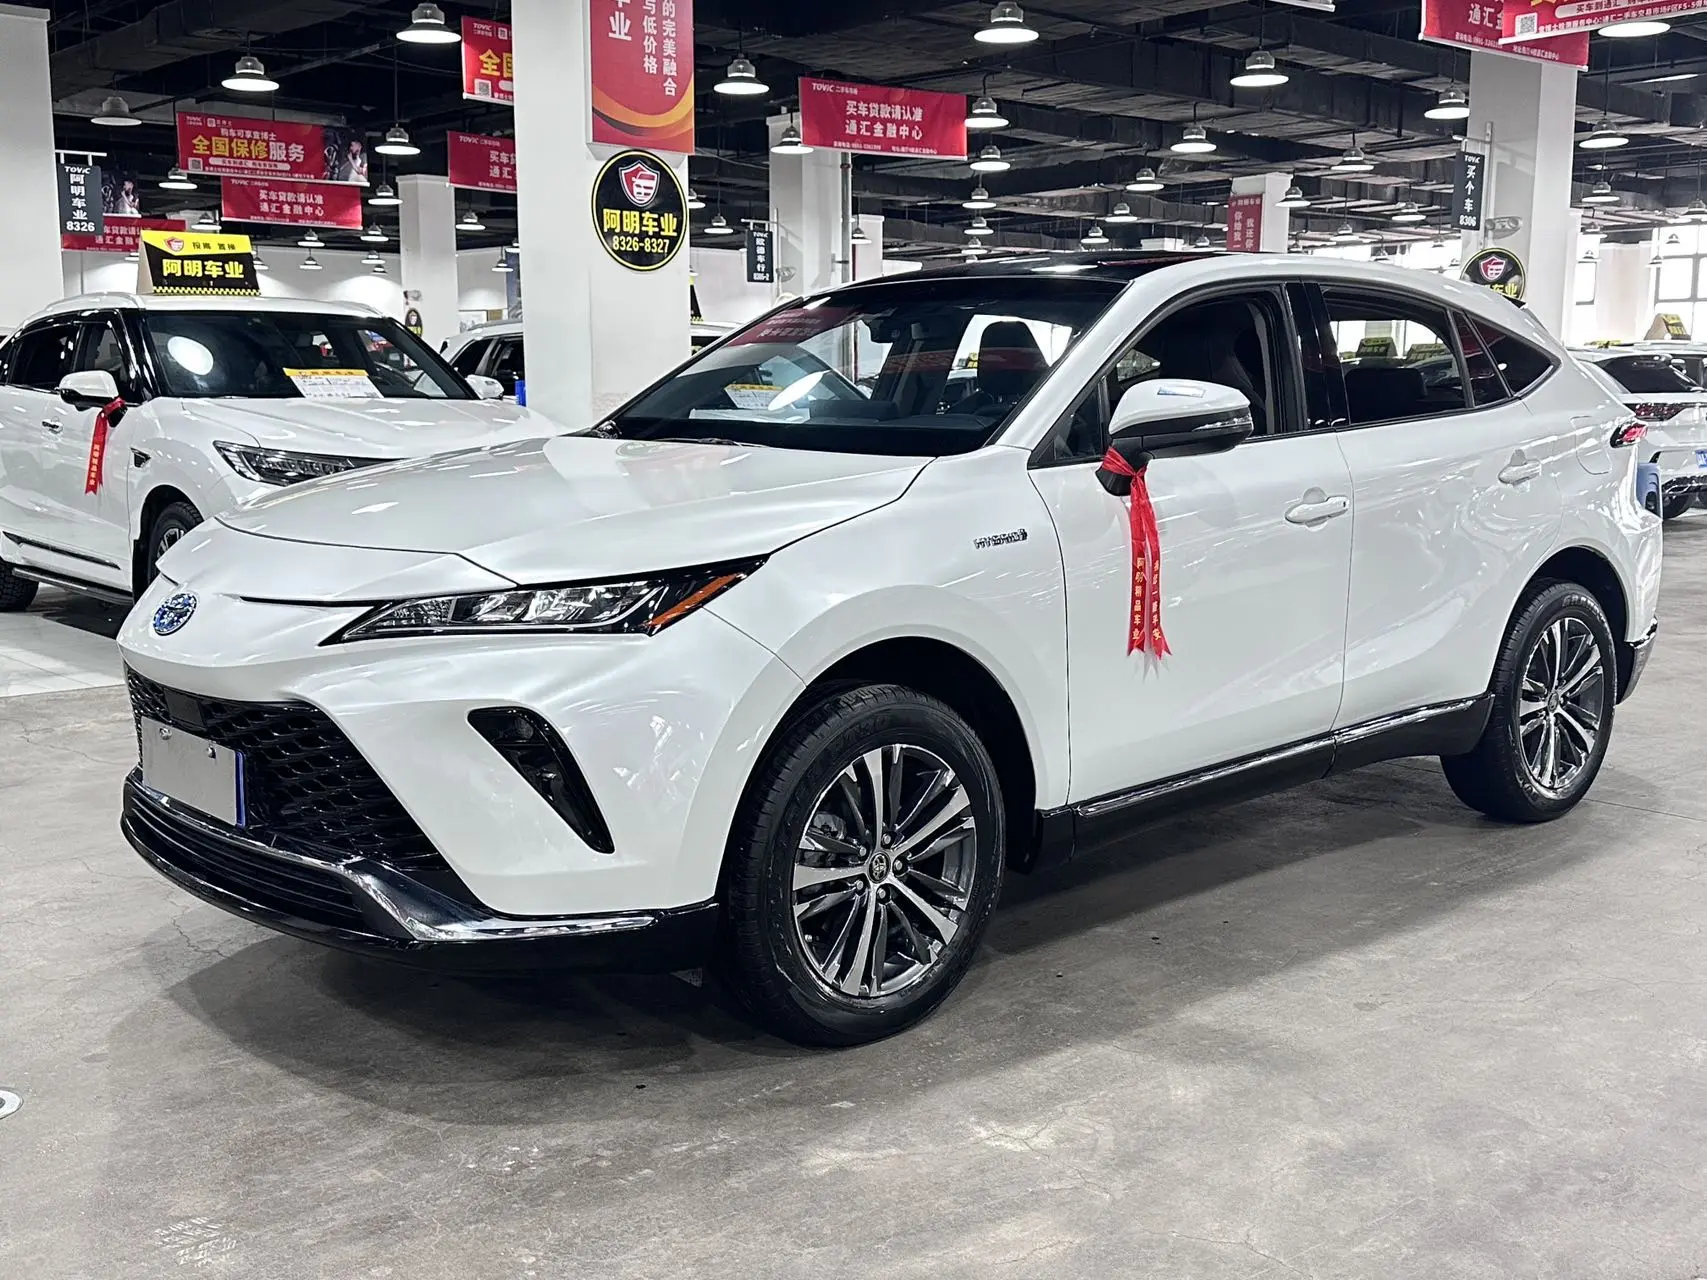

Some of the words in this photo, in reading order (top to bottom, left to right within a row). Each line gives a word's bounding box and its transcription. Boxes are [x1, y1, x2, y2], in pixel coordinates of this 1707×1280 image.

[662, 0, 677, 96] 的完美融合
[812, 83, 834, 92] TOVIC
[846, 100, 923, 121] 买车贷款请认准
[845, 120, 923, 140] 通汇金融中心
[192, 135, 305, 163] 全国保修服务
[64, 166, 91, 174] TOVIC
[489, 165, 517, 179] 通汇
[70, 174, 87, 220] 阿明车业
[258, 189, 323, 204] 买车贷款请认准
[1463, 165, 1476, 213] 买个车
[258, 202, 324, 216] 通汇金融中心
[66, 221, 95, 232] 8326
[603, 208, 677, 237] 阿明车业
[612, 236, 670, 253] 8326-8327
[1245, 218, 1254, 251] 我还你
[162, 258, 245, 279] 阿明车业
[973, 530, 1020, 549] HYBRID
